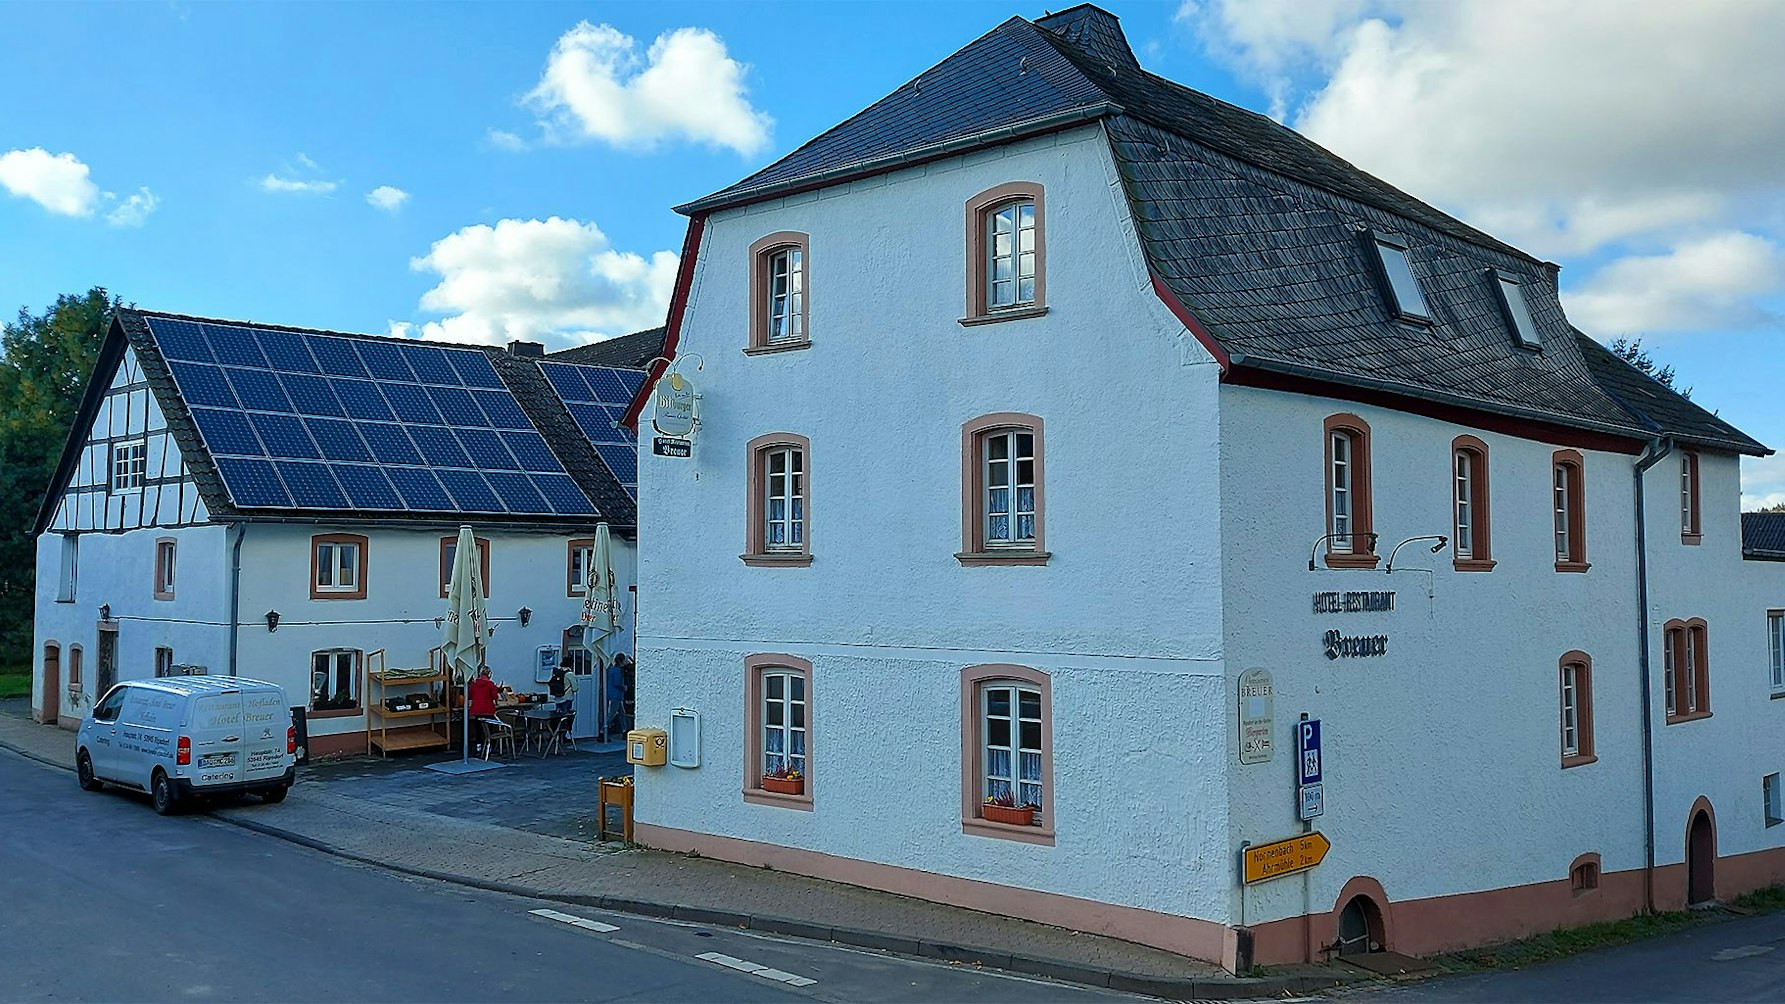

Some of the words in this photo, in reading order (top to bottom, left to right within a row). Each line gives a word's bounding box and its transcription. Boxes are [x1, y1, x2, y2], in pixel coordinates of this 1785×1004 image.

[662, 445, 687, 456] Breuer
[1323, 629, 1389, 661] Breuer
[1241, 686, 1273, 698] BREUER
[209, 712, 241, 726] Hotel
[244, 712, 274, 722] Breuer
[1303, 724, 1313, 750] P
[201, 772, 234, 781] Catering
